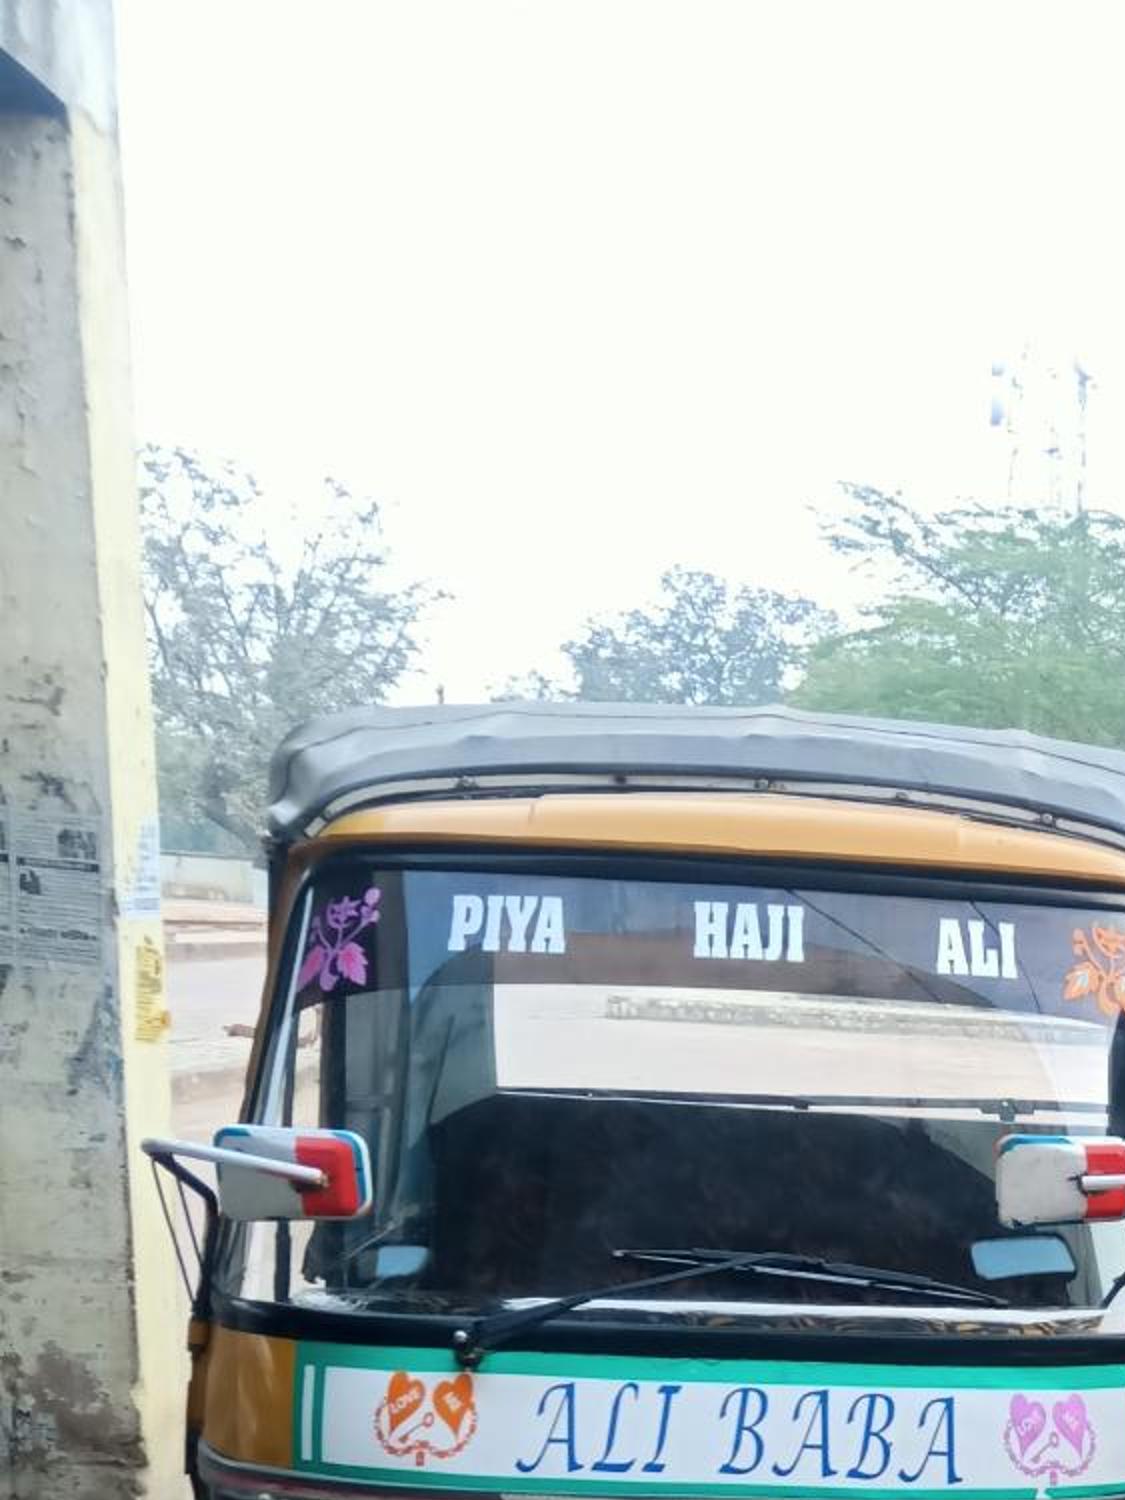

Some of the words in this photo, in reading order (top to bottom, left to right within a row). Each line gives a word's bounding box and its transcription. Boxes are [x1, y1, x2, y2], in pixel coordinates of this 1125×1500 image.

[447, 894, 566, 954] PIYA
[692, 900, 805, 963] HAJI
[935, 918, 1019, 979] ALI
[514, 1381, 683, 1474] ALI
[718, 1386, 964, 1485] BABA
